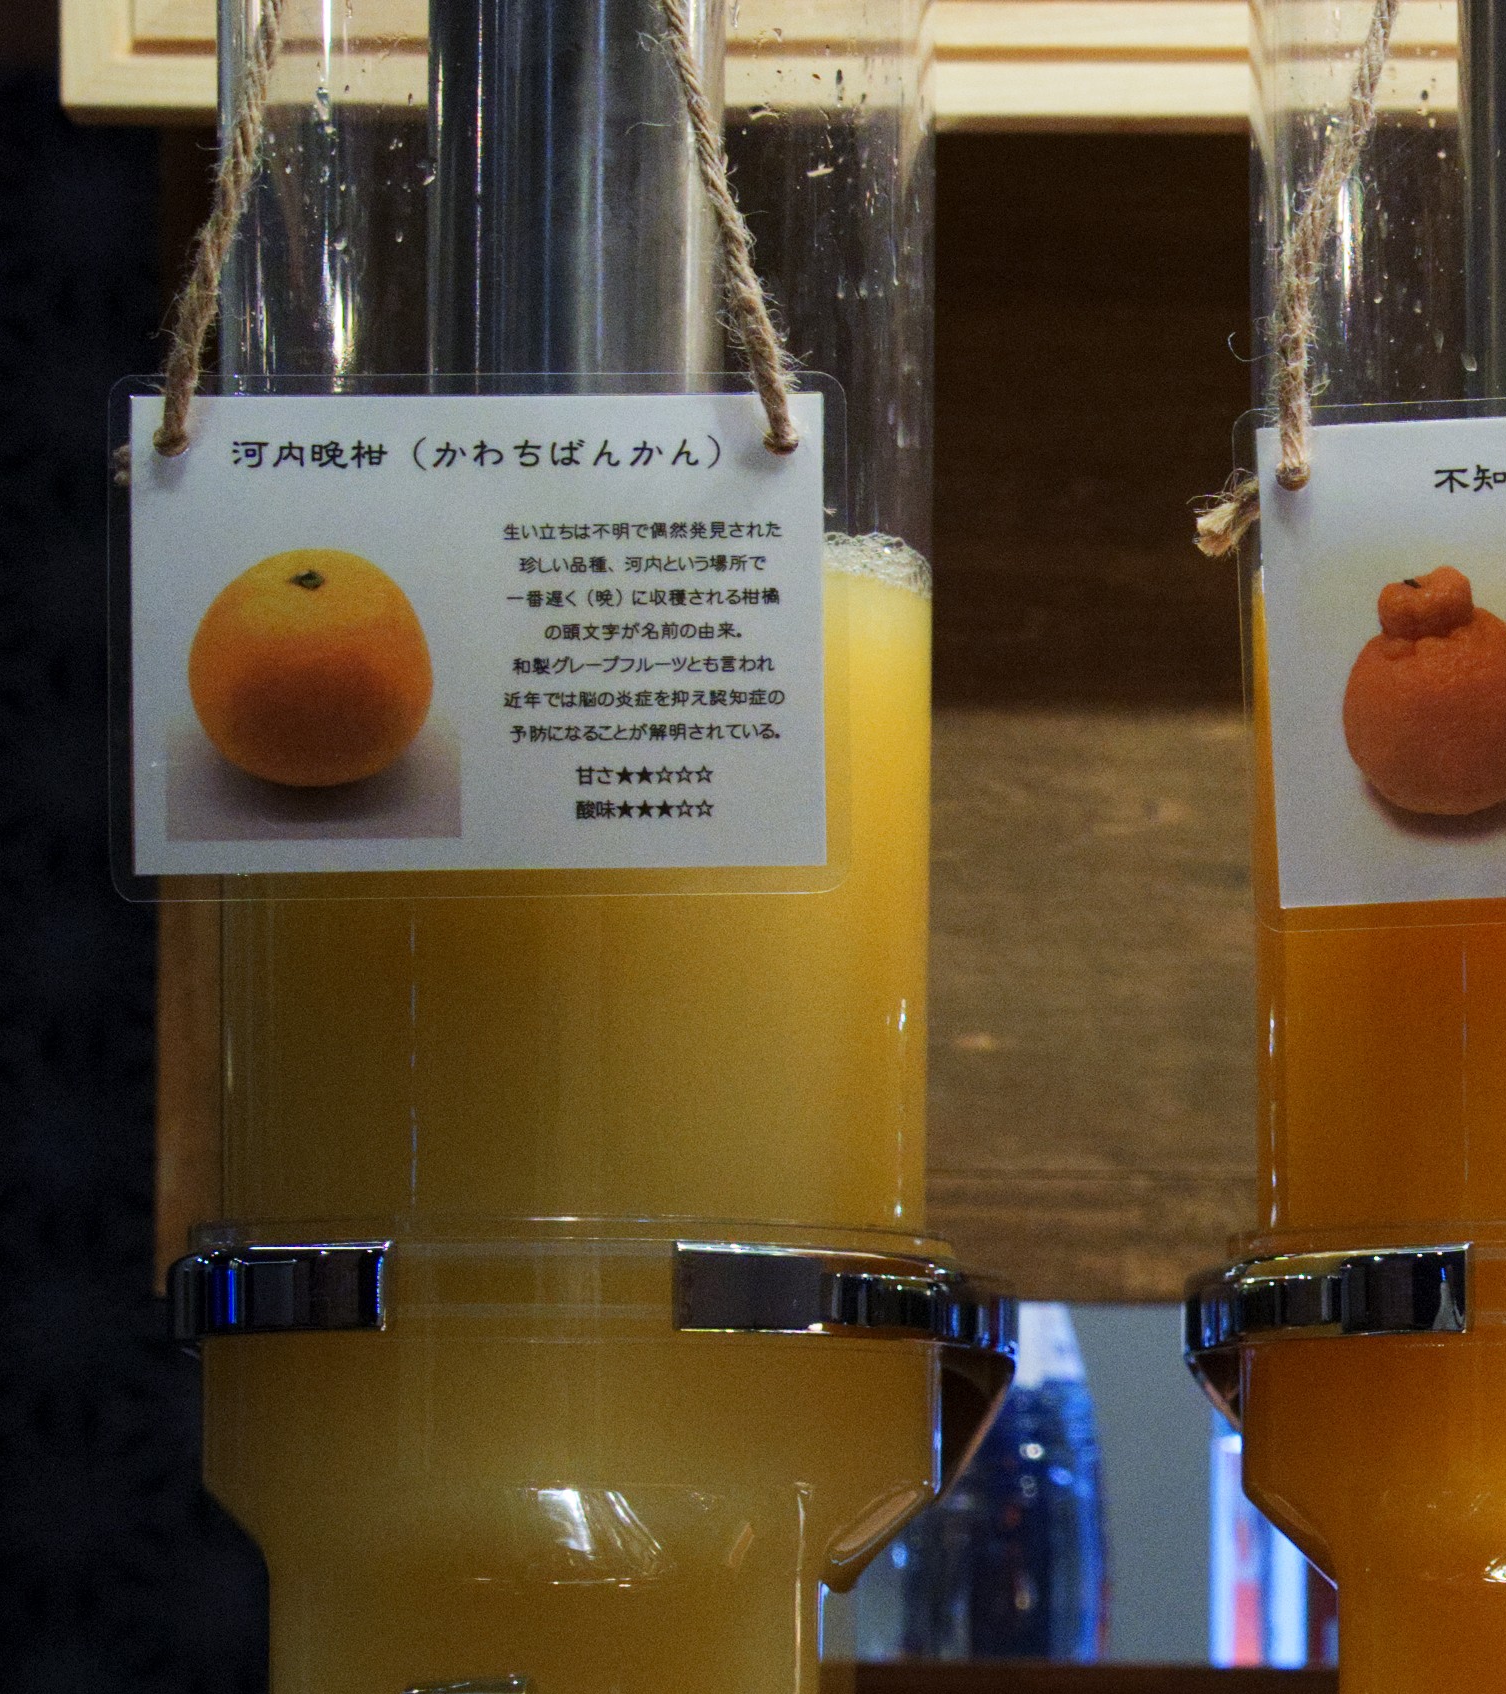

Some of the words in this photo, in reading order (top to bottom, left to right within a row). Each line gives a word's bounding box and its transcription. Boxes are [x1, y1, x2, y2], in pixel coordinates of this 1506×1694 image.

[503, 520, 781, 541] 生い立ちは不明で偶然発見された
[519, 554, 766, 574] 珍しい品種、河内という場所で
[544, 622, 742, 642] の頭文字が名前の由来。
[512, 655, 774, 676] 和製グレープフルーツとも言われ
[503, 688, 786, 710] 近年では脳の炎症を抑え認知症の
[509, 722, 781, 745] 予防になることが解明されている。
